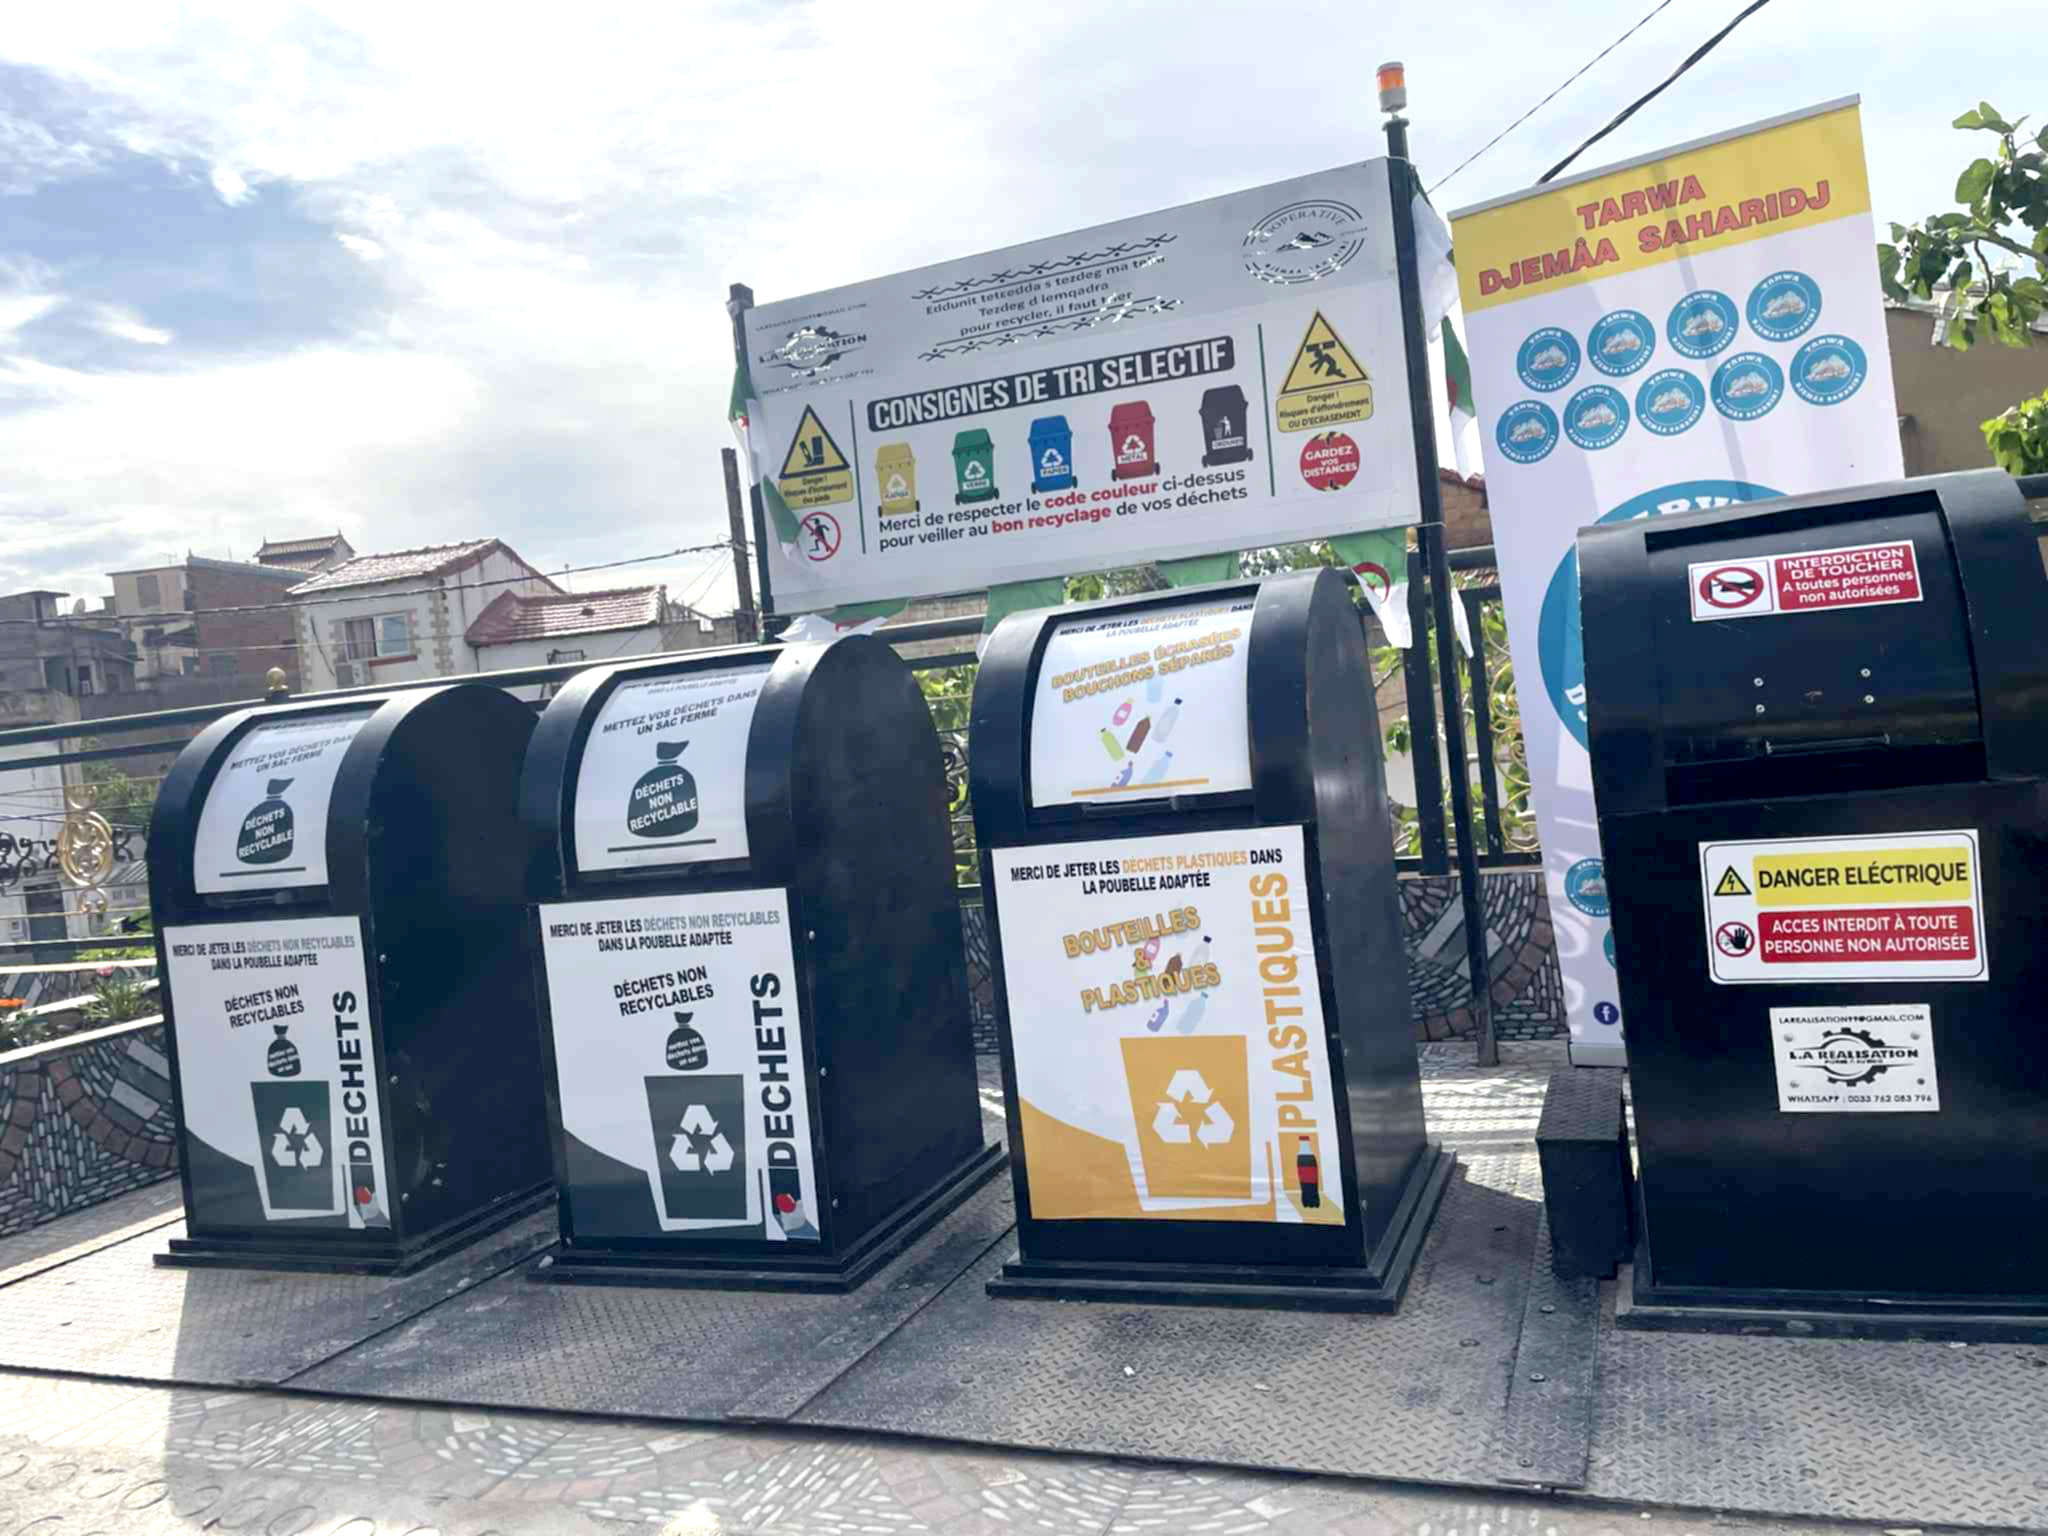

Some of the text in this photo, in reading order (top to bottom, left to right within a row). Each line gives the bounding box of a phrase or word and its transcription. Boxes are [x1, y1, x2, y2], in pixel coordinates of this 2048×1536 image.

[1577, 174, 1706, 231] TARWA
[1479, 179, 1832, 297] DJEMÂA SAHARIDJ
[926, 296, 977, 315] Eddunit
[1045, 280, 1053, 289] s
[1106, 263, 1129, 275] ma
[960, 321, 991, 337] pour
[1056, 305, 1064, 315] il
[1069, 297, 1097, 311] faut
[979, 299, 1026, 317] Tezdeg
[1028, 296, 1038, 307] d
[873, 380, 1011, 429] CONSIGNES
[1013, 372, 1049, 403] DE
[1053, 363, 1096, 398] TRI
[1102, 338, 1230, 388] SELECTIF
[1304, 445, 1353, 461] GARDEZ
[1303, 462, 1358, 477] DISTANCES
[878, 468, 1246, 533] Merci de respecter le code couleur ci-dessus
[879, 485, 1248, 553] pour veiller au bon recyclage de vos déchets
[1781, 547, 1905, 571] INTERDICTION
[1790, 559, 1903, 580] DE TOUCHER
[1782, 568, 1914, 593] A toutes personnes
[1799, 582, 1901, 604] non autorisées
[1062, 666, 1155, 704] BOUCHONS
[602, 715, 647, 734] METTEZ
[648, 709, 671, 722] VOS
[726, 688, 757, 701] DANS
[636, 724, 654, 736] UN
[655, 719, 678, 731] SAC
[273, 757, 293, 768] SAC
[649, 792, 673, 809] NON
[629, 798, 698, 832] RECYCLABLE
[255, 825, 275, 840] NON
[1010, 864, 1045, 882] MERCI
[1046, 864, 1061, 879] DE
[1063, 862, 1098, 878] JETER
[1100, 860, 1121, 876] LES
[1176, 850, 1248, 870] PLASTIQUES
[1249, 848, 1283, 865] DANS
[1759, 859, 1968, 889] DANGER ELÉCTRIQUE
[1082, 870, 1211, 895] LA POUBELLE ADAPTÉE
[549, 924, 579, 938] MERCI
[580, 922, 593, 937] DE
[594, 921, 625, 936] JETER
[626, 919, 643, 934] LES
[688, 915, 711, 930] NON
[711, 910, 781, 928] RECYCLABLES
[1061, 906, 1201, 958] BOUTEILLES
[1772, 912, 1958, 934] ACCES INTERDIT À TOUTE
[208, 943, 231, 955] JETER
[232, 941, 246, 953] LES
[598, 938, 624, 952] DANS
[625, 937, 638, 951] LA
[639, 934, 687, 950] POUBELLE
[1764, 932, 1970, 955] PERSONNE NON AUTORISÉE
[233, 957, 243, 969] LA
[1133, 948, 1153, 970] &
[613, 965, 708, 998] DÉCHETS NON
[1080, 963, 1223, 1012] PLASTIQUES
[224, 984, 299, 1012] DÉCHETS NON
[619, 983, 715, 1018] RECYCLABLES
[1250, 872, 1318, 1129] PLASTIQUES
[229, 1000, 305, 1029] RECYCLABLES
[1818, 1049, 1920, 1060] REALISATION
[332, 990, 372, 1163] DECHETS
[750, 972, 799, 1168] DECHETS
[1787, 1095, 1840, 1104] WHATSAPP
